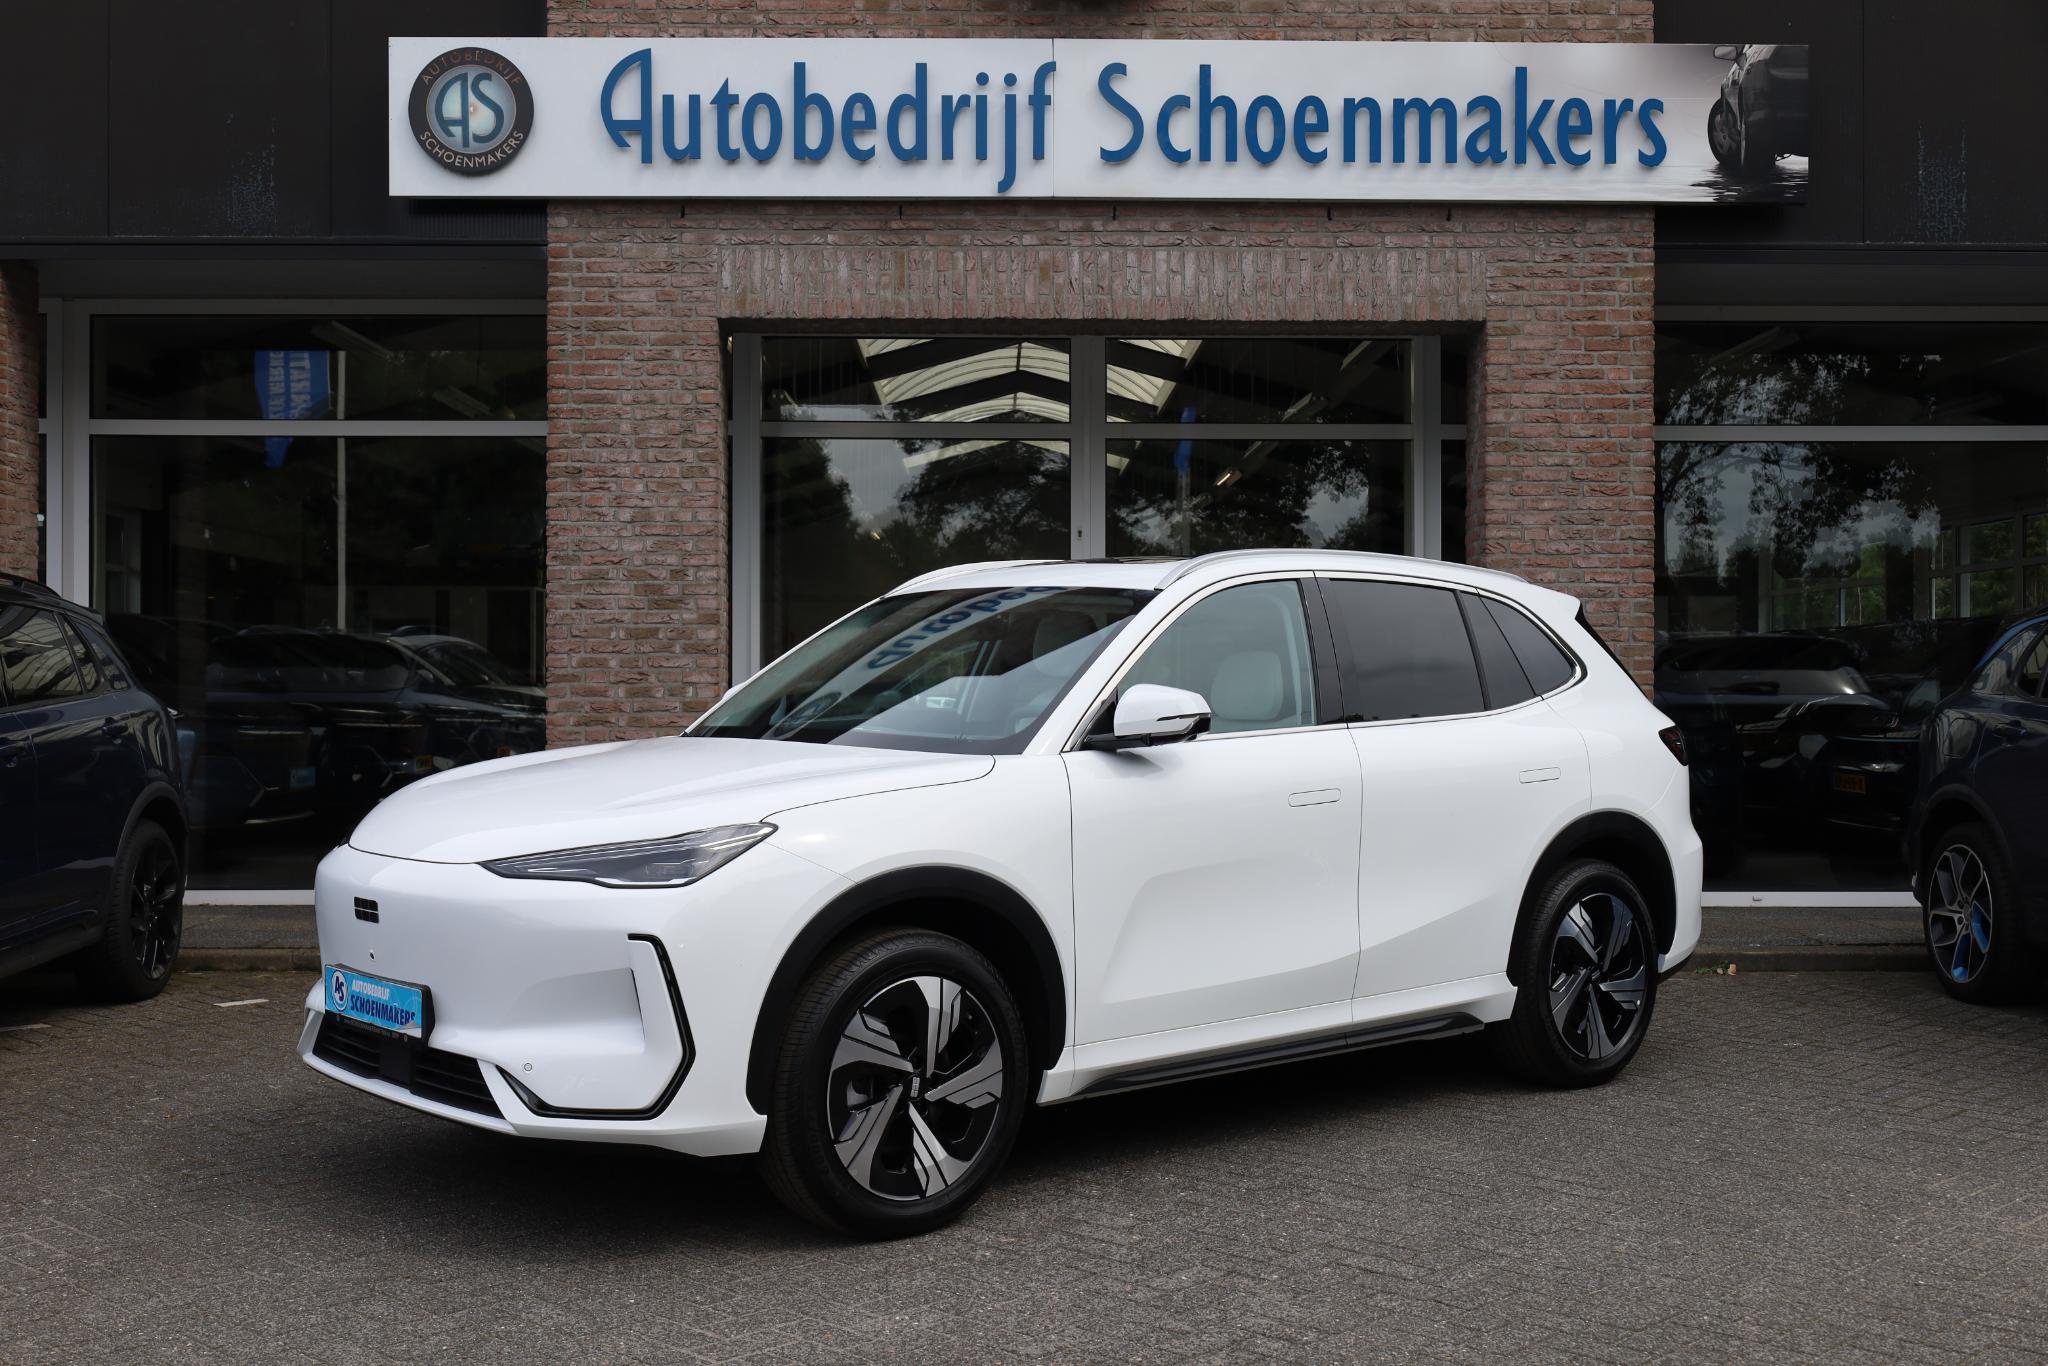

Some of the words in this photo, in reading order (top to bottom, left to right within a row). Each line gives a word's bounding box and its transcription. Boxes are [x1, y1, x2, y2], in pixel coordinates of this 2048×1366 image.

[422, 51, 523, 86] AUTOBEDRIJF
[435, 72, 504, 148] AS
[600, 48, 1056, 193] Autobedrijf
[1098, 62, 1667, 167] Schoenmakers
[420, 130, 524, 168] SCHOENMAKERS
[335, 976, 344, 1002] AS
[352, 980, 390, 1000] AUTOBEDRIJF
[350, 994, 415, 1026] SCHOENMAKERS
